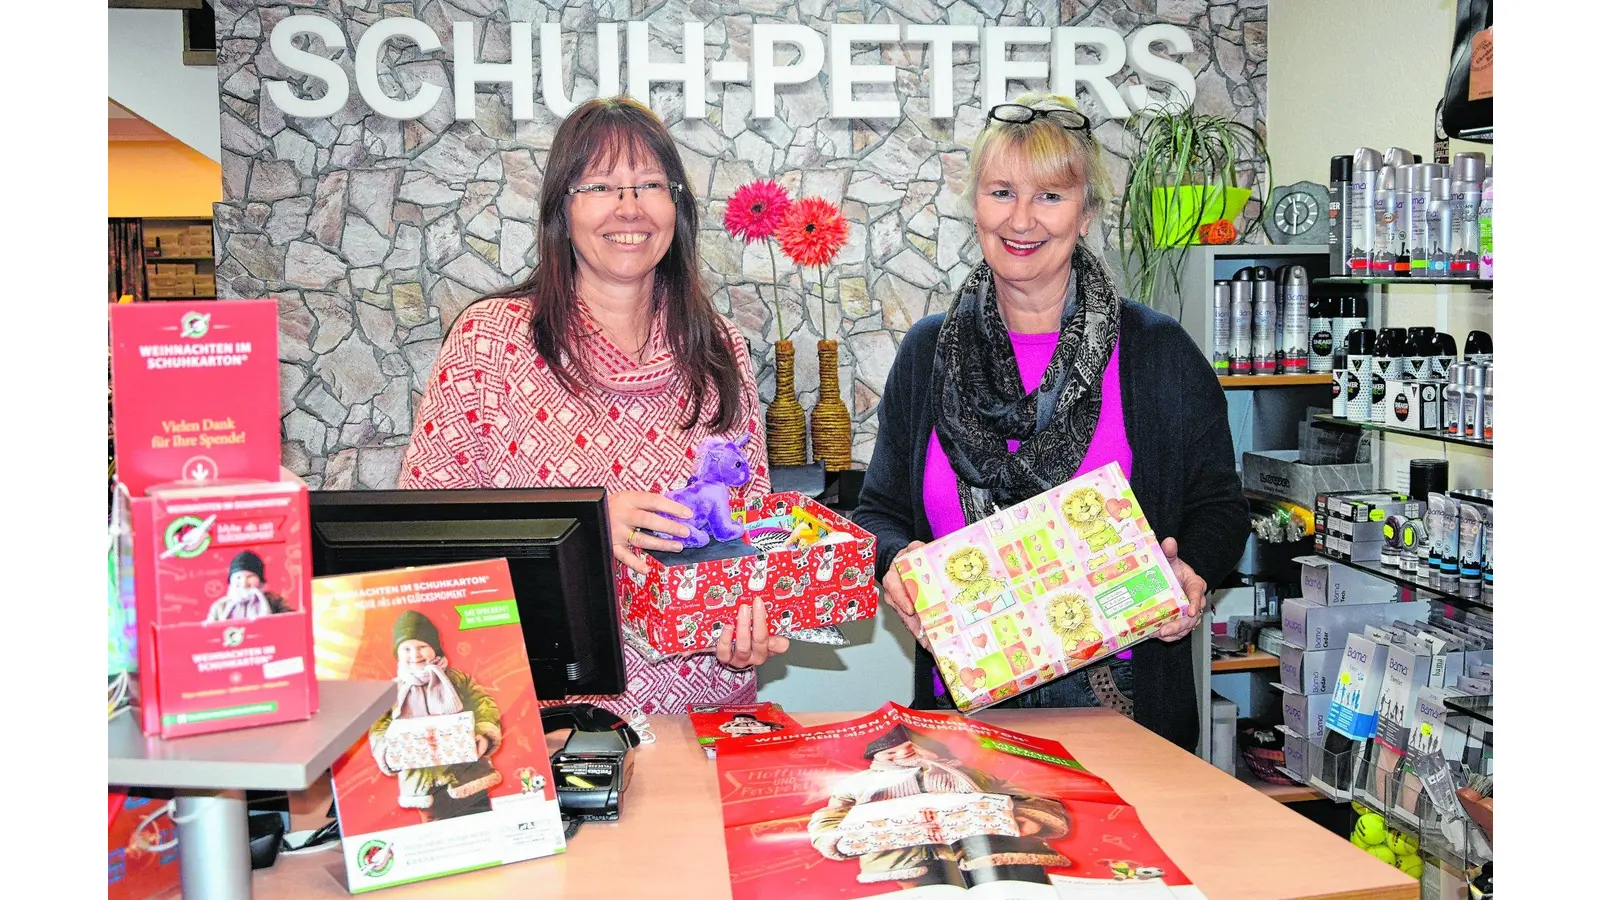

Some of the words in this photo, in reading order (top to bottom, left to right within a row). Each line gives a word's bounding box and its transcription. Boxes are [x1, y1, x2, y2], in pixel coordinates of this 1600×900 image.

[267, 15, 1196, 119] SCHUH-PETERS
[139, 343, 234, 357] WEIHNACHTEN
[235, 342, 252, 353] IM
[162, 420, 200, 433] Vielen
[203, 417, 235, 431] Dank
[152, 436, 170, 448] für
[173, 433, 197, 447] Ihre
[200, 431, 246, 448] Spende!
[407, 588, 466, 605] GLÜCKSMOMENT
[1347, 646, 1367, 663] Bama
[1389, 657, 1408, 676] Bama
[755, 719, 880, 743] WEIHNACHTEN
[883, 708, 898, 720] IM
[805, 733, 840, 742] MEHR
[844, 730, 866, 739] als
[868, 719, 890, 734] ein
